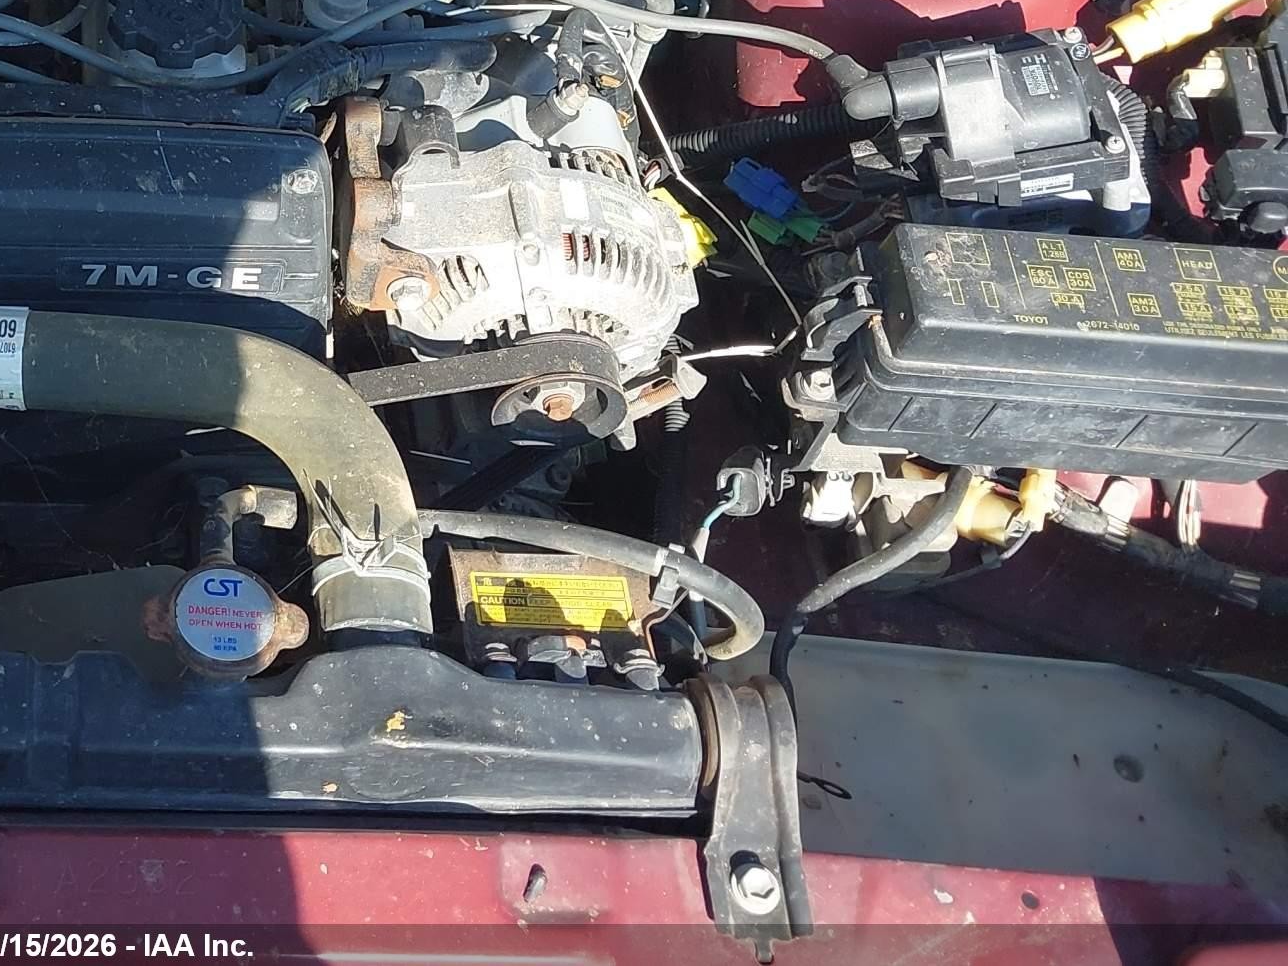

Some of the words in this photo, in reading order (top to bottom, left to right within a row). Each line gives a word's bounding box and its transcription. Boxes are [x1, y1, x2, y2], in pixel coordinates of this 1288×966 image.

[1041, 241, 1063, 251] ALT
[1117, 251, 1139, 261] AM1
[1119, 259, 1142, 268] 40A
[1182, 259, 1213, 270] HEAD
[1068, 271, 1089, 280] CDS
[1070, 279, 1092, 288] 30A
[1132, 296, 1155, 306] AM2
[1077, 320, 1140, 332] 2672-14010
[204, 578, 243, 597] CST
[479, 596, 527, 607] CAUTION
[188, 605, 230, 617] DANGER!
[232, 610, 263, 619] NEVER
[188, 618, 213, 627] OPEN
[215, 621, 242, 630] WHEN
[244, 622, 263, 631] HOT
